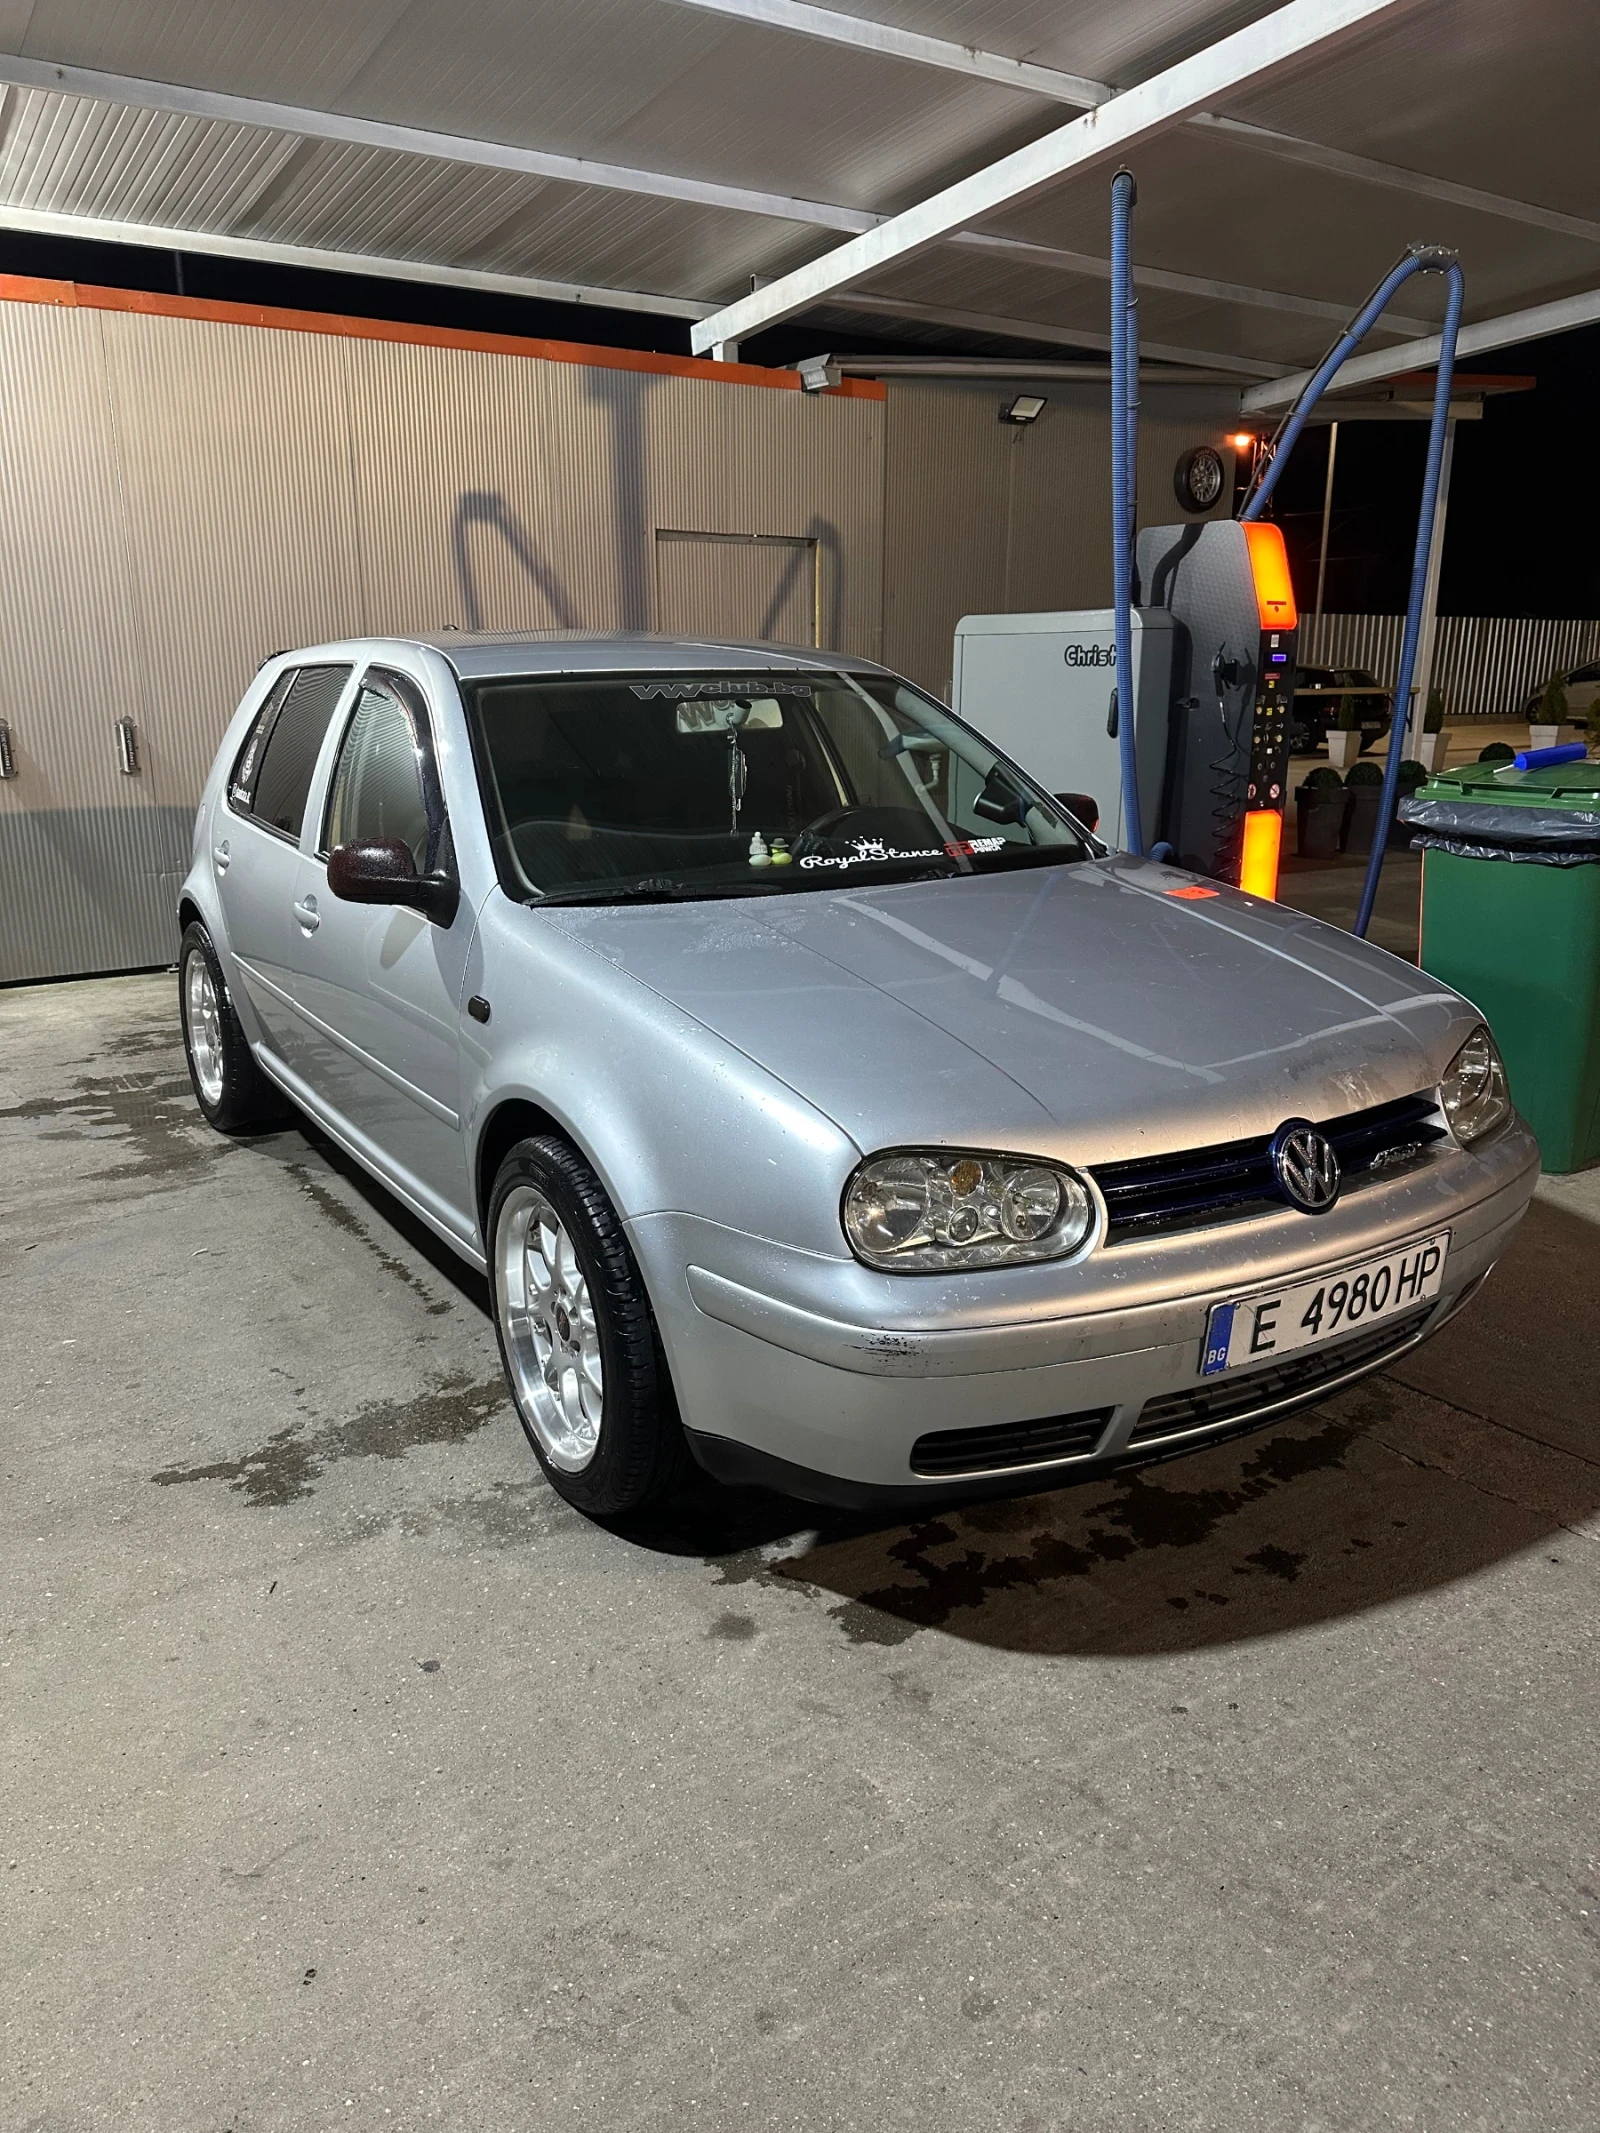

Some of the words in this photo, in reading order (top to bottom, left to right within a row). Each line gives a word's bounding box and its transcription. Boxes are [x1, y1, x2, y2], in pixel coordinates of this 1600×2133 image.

[1250, 1300, 1282, 1354] E
[1301, 1266, 1391, 1336] 4980
[1395, 1246, 1441, 1304] HP
[1207, 1347, 1226, 1365] BG
